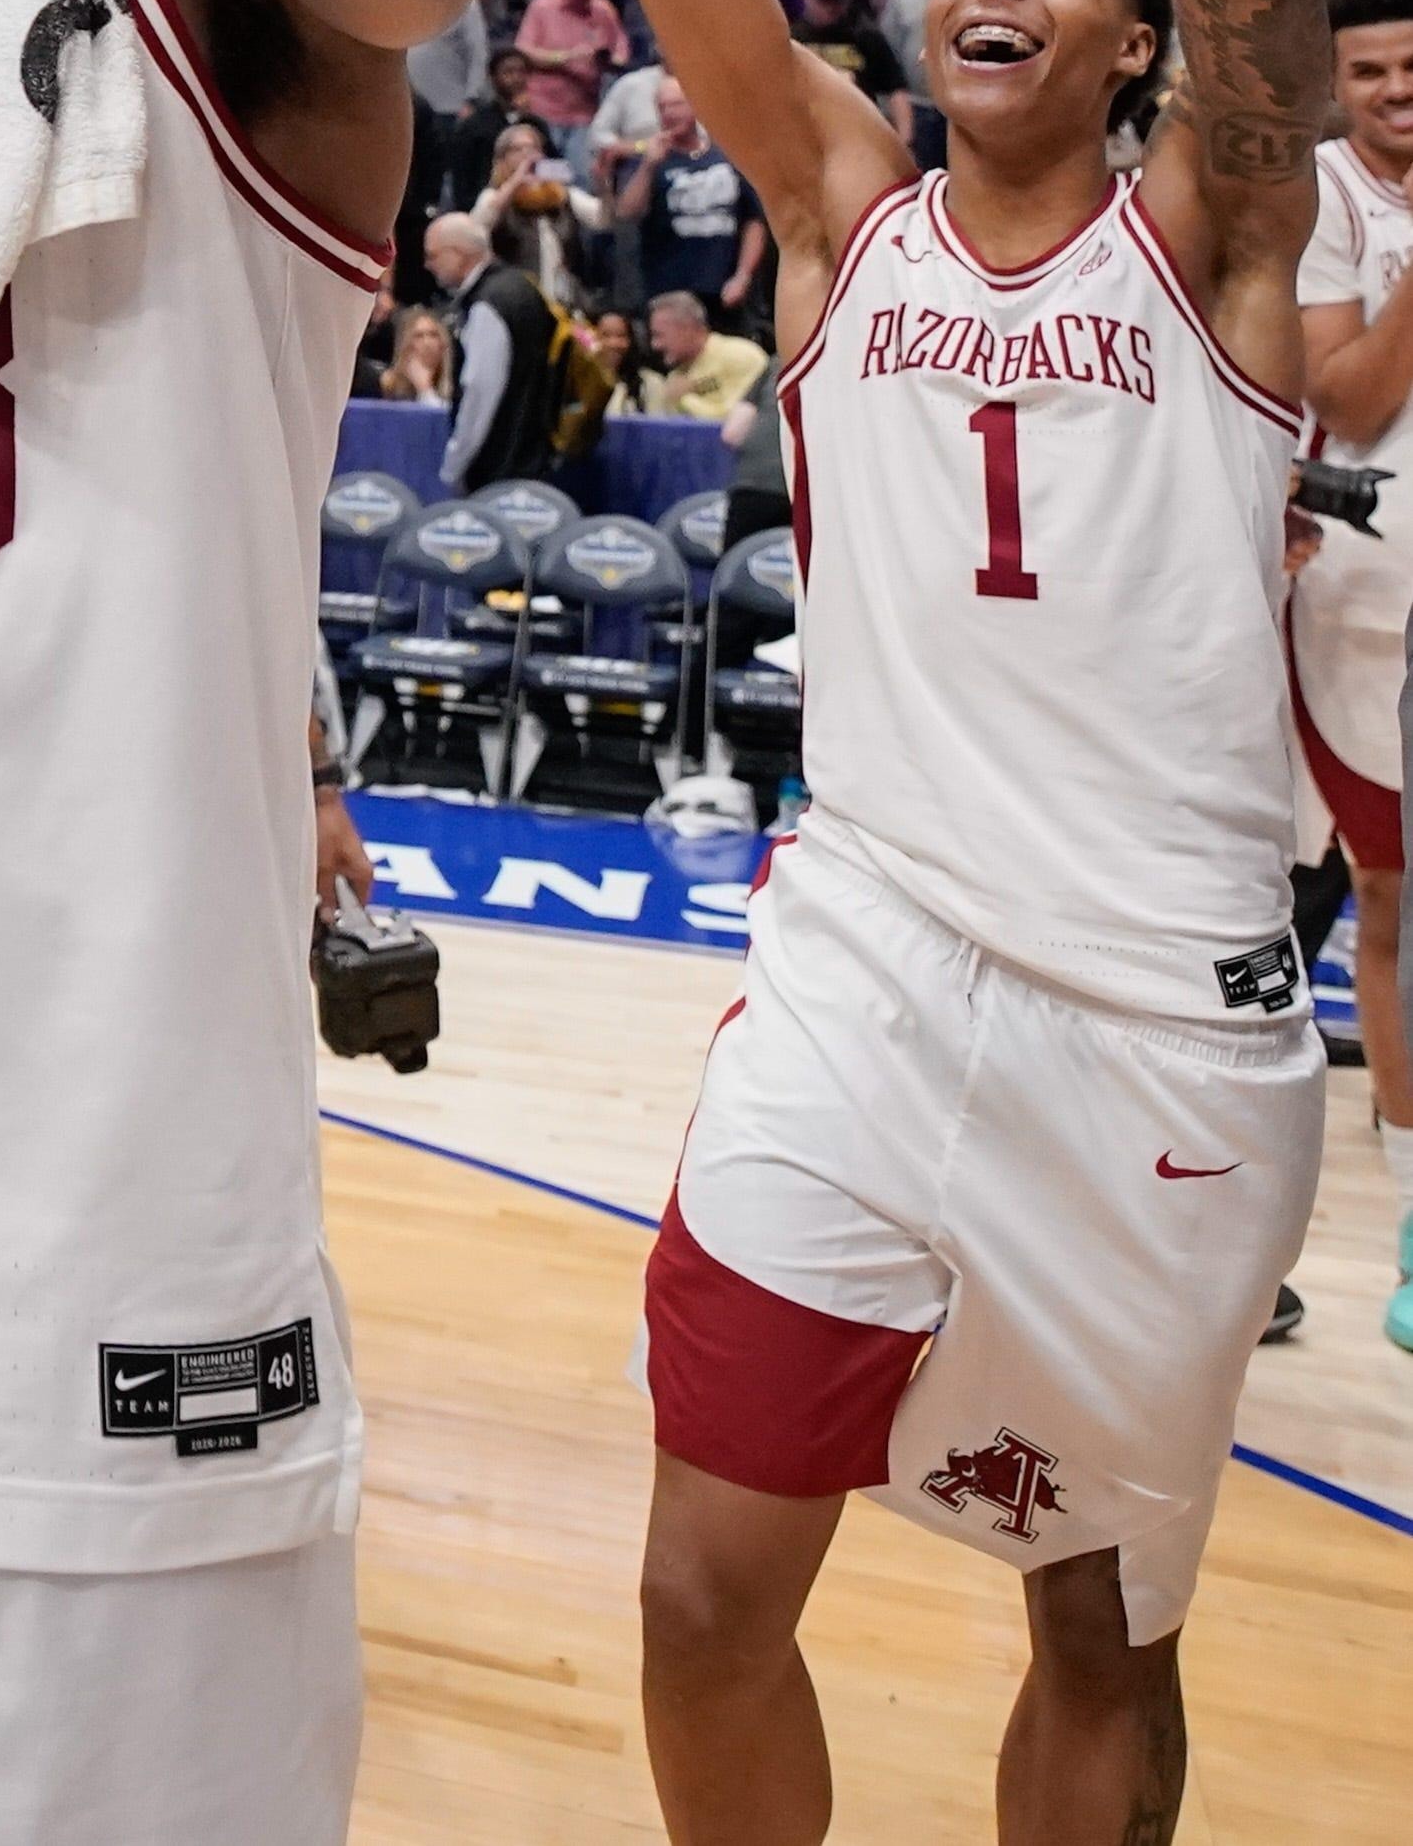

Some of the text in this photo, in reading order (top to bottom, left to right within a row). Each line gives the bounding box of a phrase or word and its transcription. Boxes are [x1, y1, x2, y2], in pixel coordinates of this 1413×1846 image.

[969, 401, 1039, 600] 1
[267, 1352, 295, 1391] 48
[115, 1399, 169, 1415] TEAM
